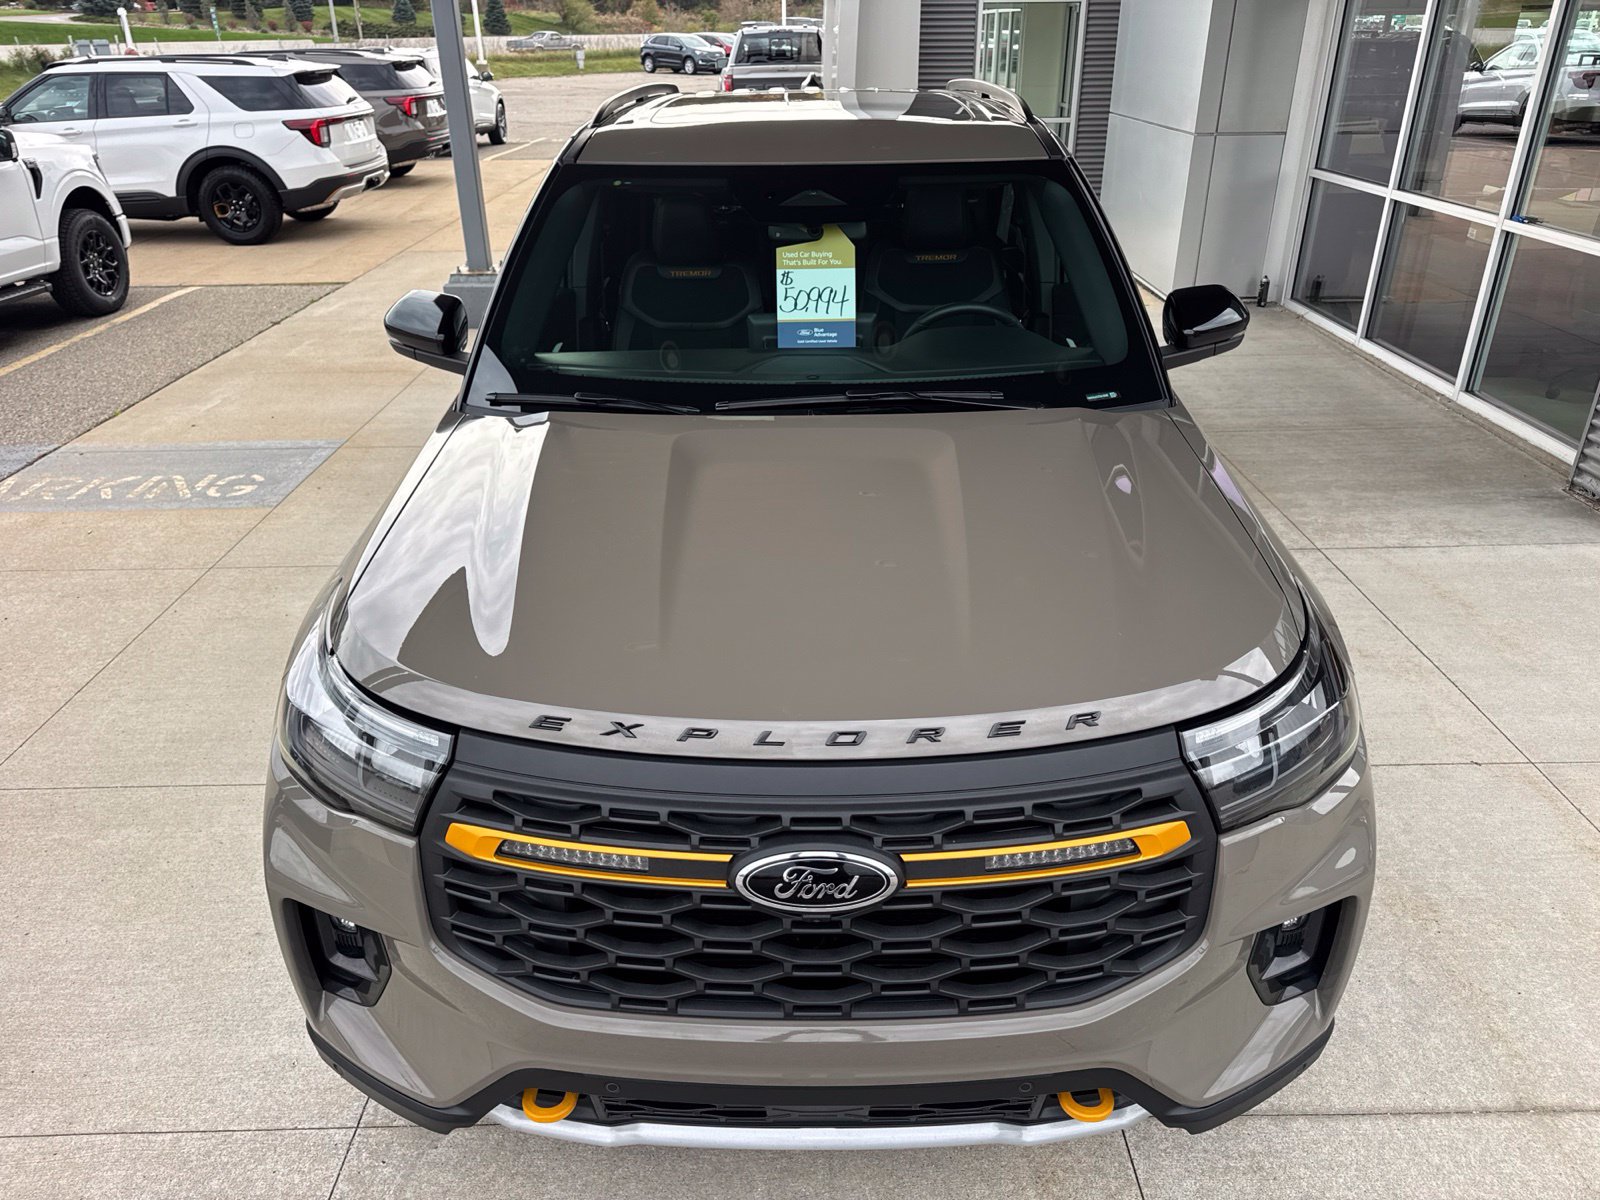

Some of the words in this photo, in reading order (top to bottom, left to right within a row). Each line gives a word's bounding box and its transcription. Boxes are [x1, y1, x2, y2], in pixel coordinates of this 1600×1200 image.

[0, 474, 265, 500] RKING
[528, 710, 1101, 747] EXPLORER
[774, 865, 860, 900] Ford
